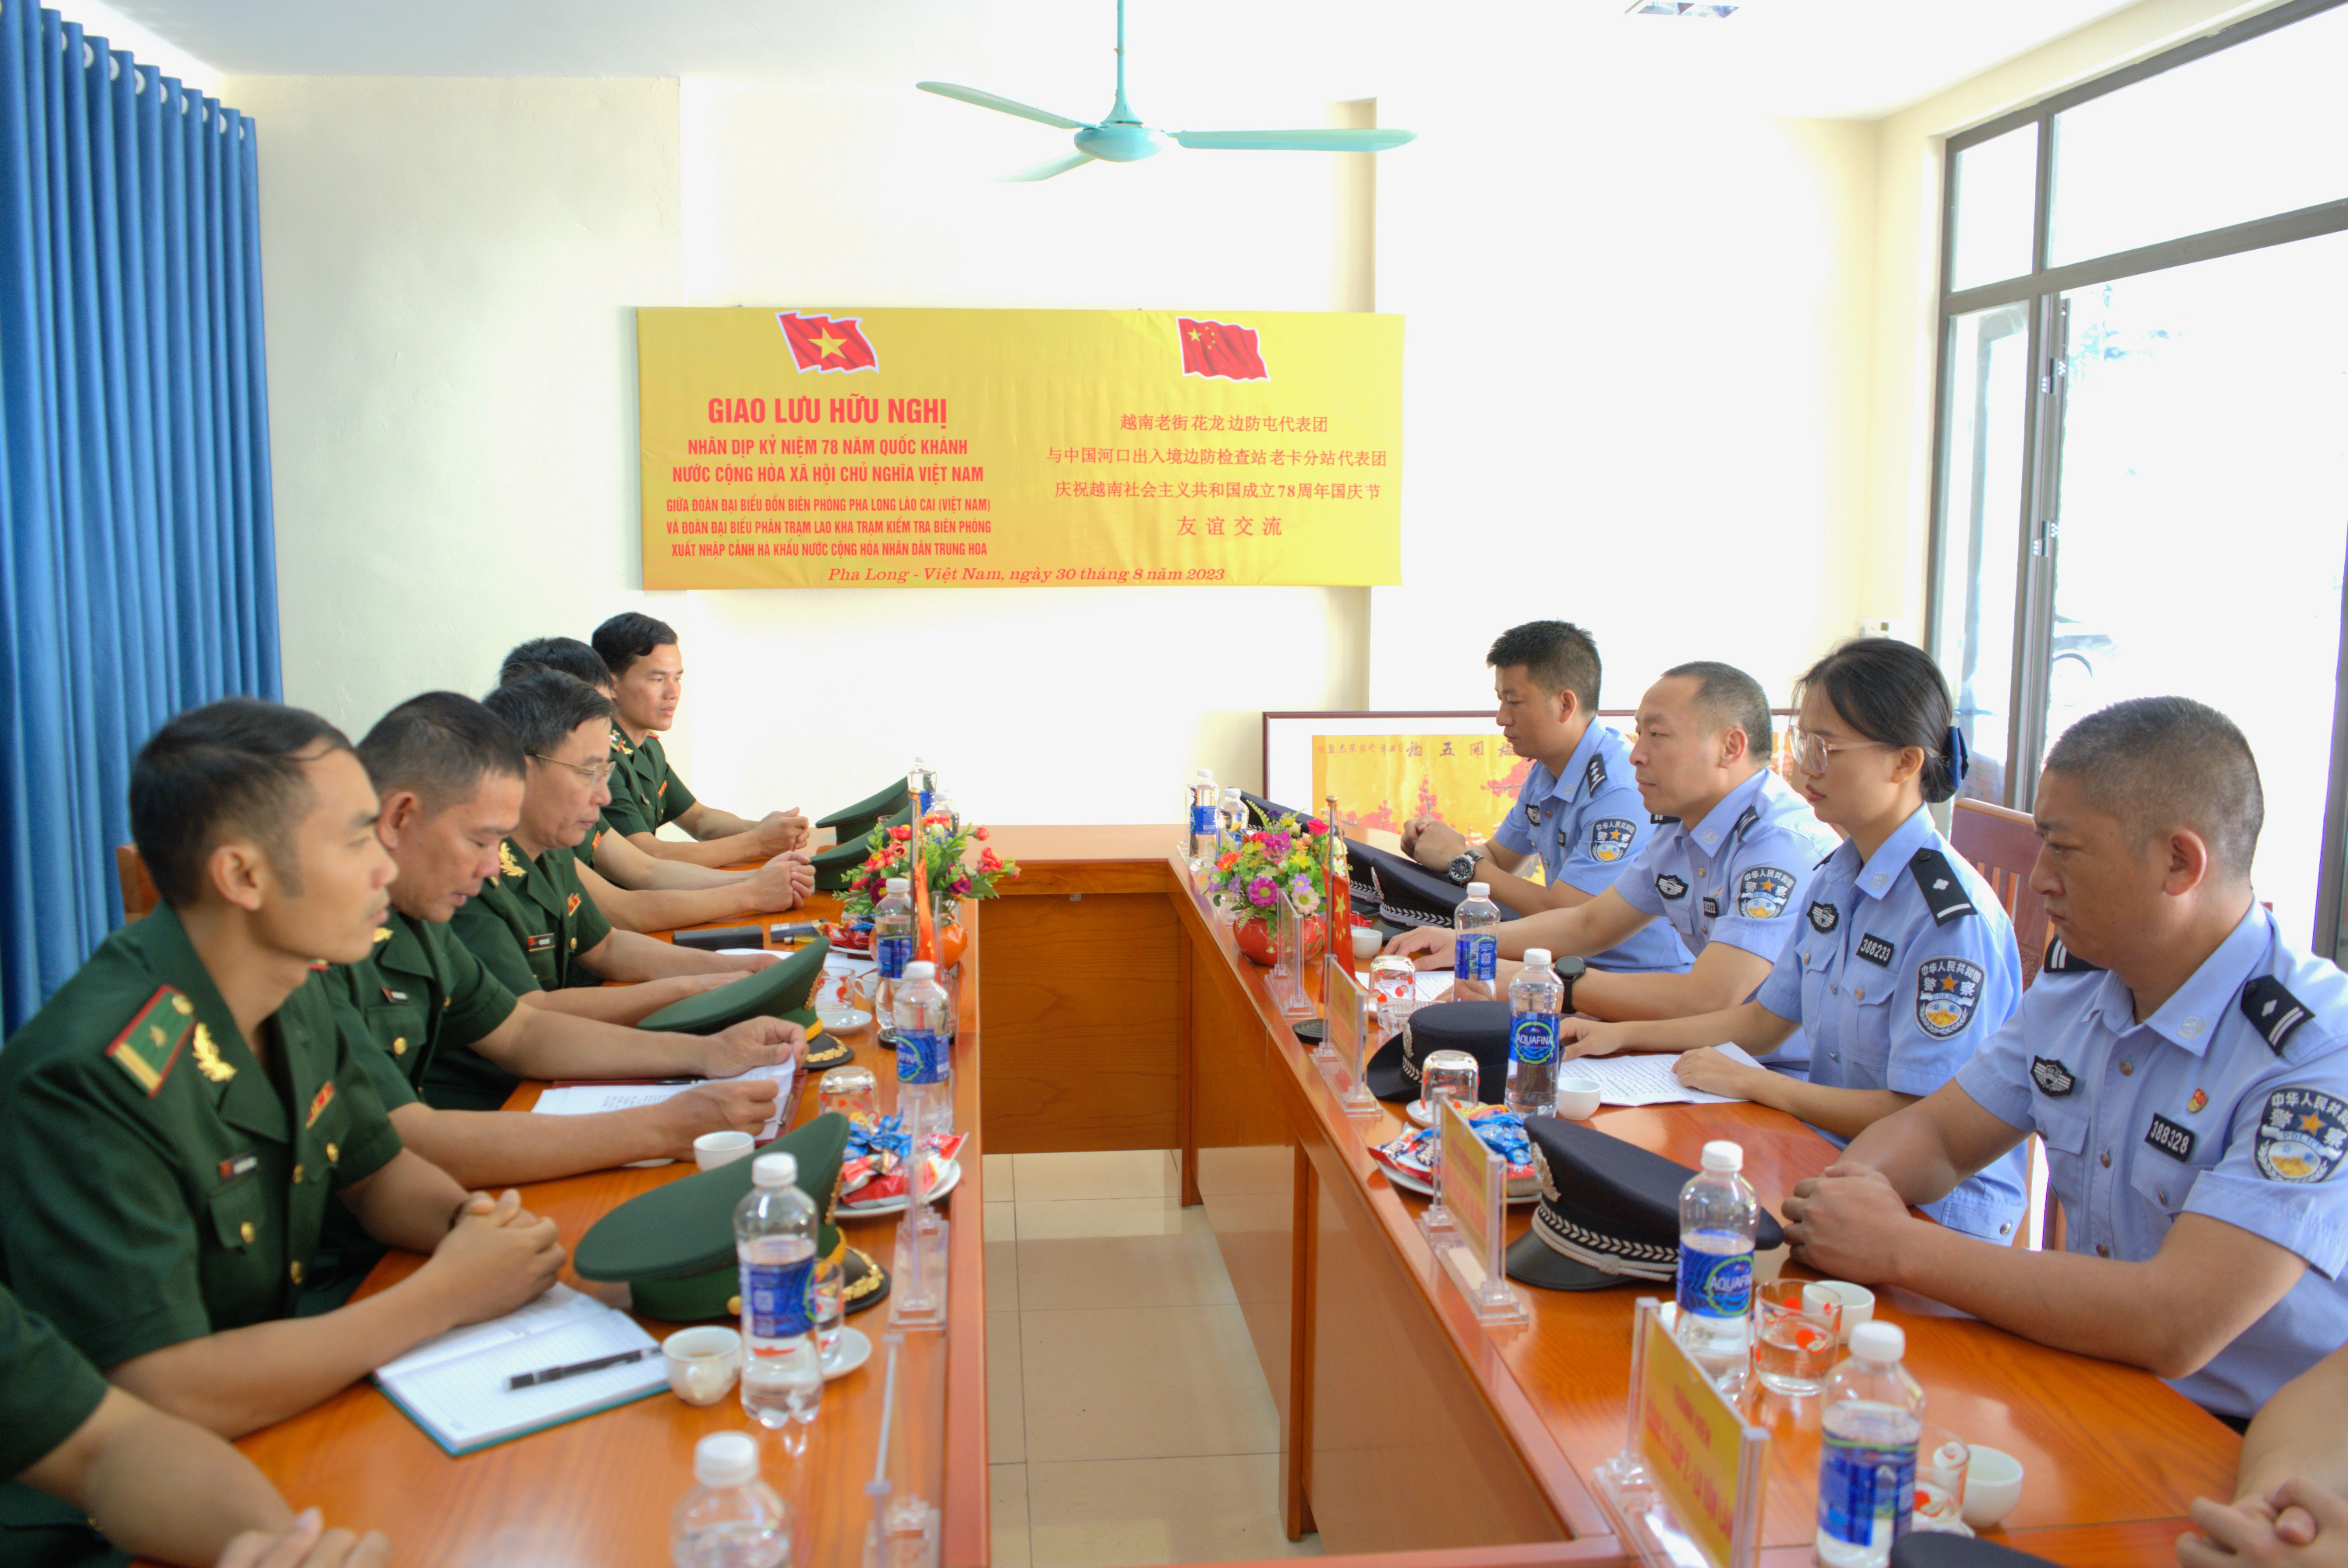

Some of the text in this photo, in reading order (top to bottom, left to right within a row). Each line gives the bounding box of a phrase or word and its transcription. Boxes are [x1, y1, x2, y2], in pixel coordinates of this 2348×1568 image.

[708, 393, 947, 429] GIAO LƯU HỮU NGHỊ
[688, 433, 968, 458] NHÂN DỊP KỶ NIỆM 78 NĂM QUỐC KHÁNH
[672, 461, 984, 486] NƯỚC CỘNG HÒA XÃ HỘI CHỦ NGHĨA VIỆT NAM
[666, 493, 990, 514] GIỮA ĐOÀN ĐẠI BIỂU ĐỒN BIÊN PHÒNG PHA LONG LÀO CAI (VIỆT NAM)
[666, 516, 992, 537] VÀ ĐOÀN ĐẠI BIỂU PHÂN TRẠM LAO KHA TRẠM KIỂM TRA BIÊN PHÒNG
[672, 539, 987, 559] XUẤT NHẬP CẢNH HÀ KHẨU NƯỚC CỘNG HÒA NHÂN DÂN TRUNG HOA
[827, 568, 860, 581] Pha
[865, 568, 910, 584] Long
[924, 567, 958, 584] Việt
[960, 567, 1004, 582] Nam,
[1009, 567, 1053, 584] ngày
[1055, 568, 1077, 580] 30
[1080, 567, 1130, 583] tháng
[1132, 568, 1144, 580] 8
[1146, 568, 1182, 580] năm
[1186, 569, 1225, 580] 2023
[1744, 869, 1794, 888] 中华人民共和国
[1860, 939, 1891, 961] 388233
[1921, 961, 1982, 983] 中华人民共和国
[1933, 994, 1960, 1003] POLICE
[1516, 1033, 1553, 1045] AQUAFINA
[2271, 1091, 2348, 1132] 中华人民共和
[2151, 1120, 2190, 1155] 388328
[2282, 1131, 2323, 1150] POLICE
